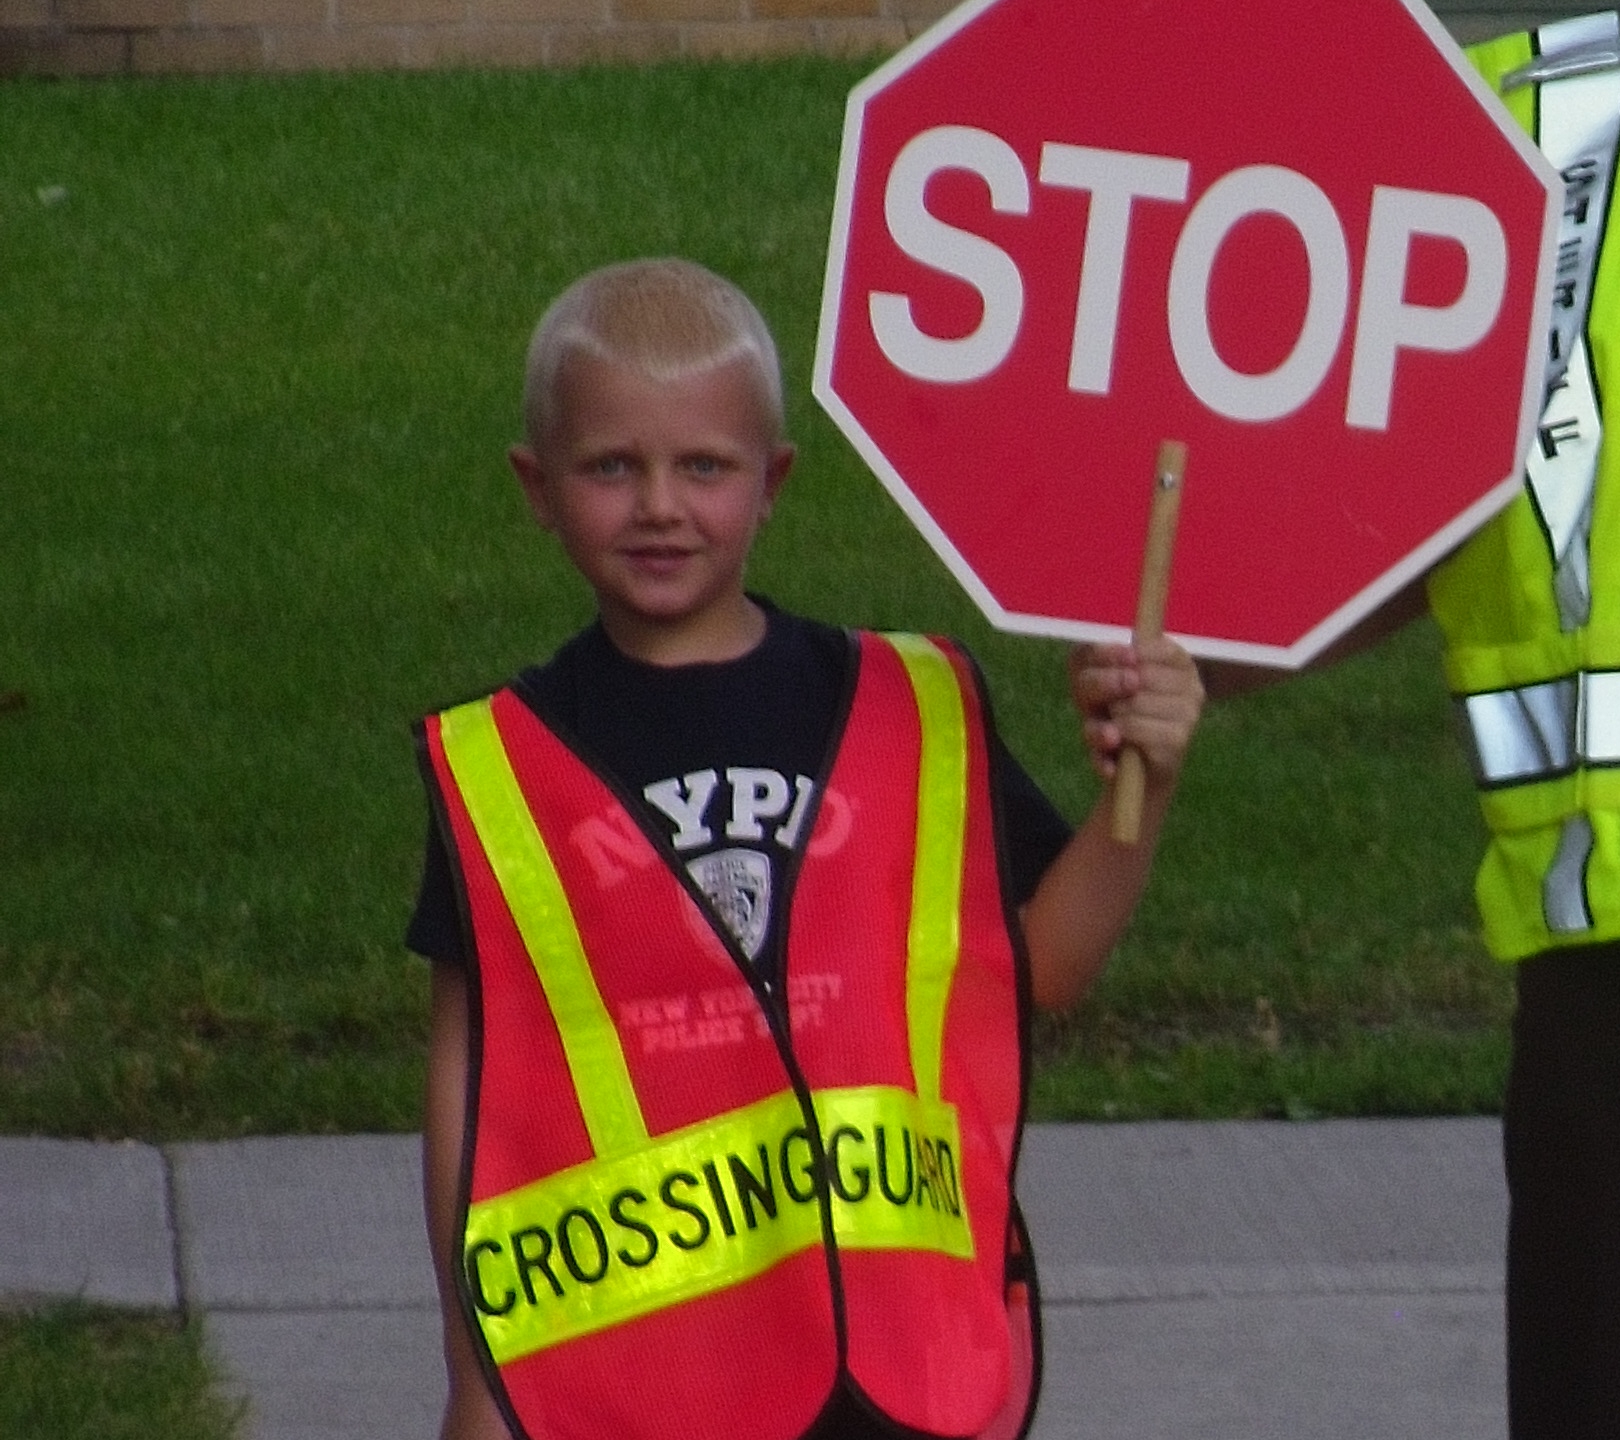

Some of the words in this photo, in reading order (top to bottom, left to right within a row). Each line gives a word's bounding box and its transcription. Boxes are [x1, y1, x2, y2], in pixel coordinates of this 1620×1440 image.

[868, 125, 1510, 432] STOP
[465, 1127, 818, 1317] CROSSING
[827, 1124, 962, 1221] GUARD
